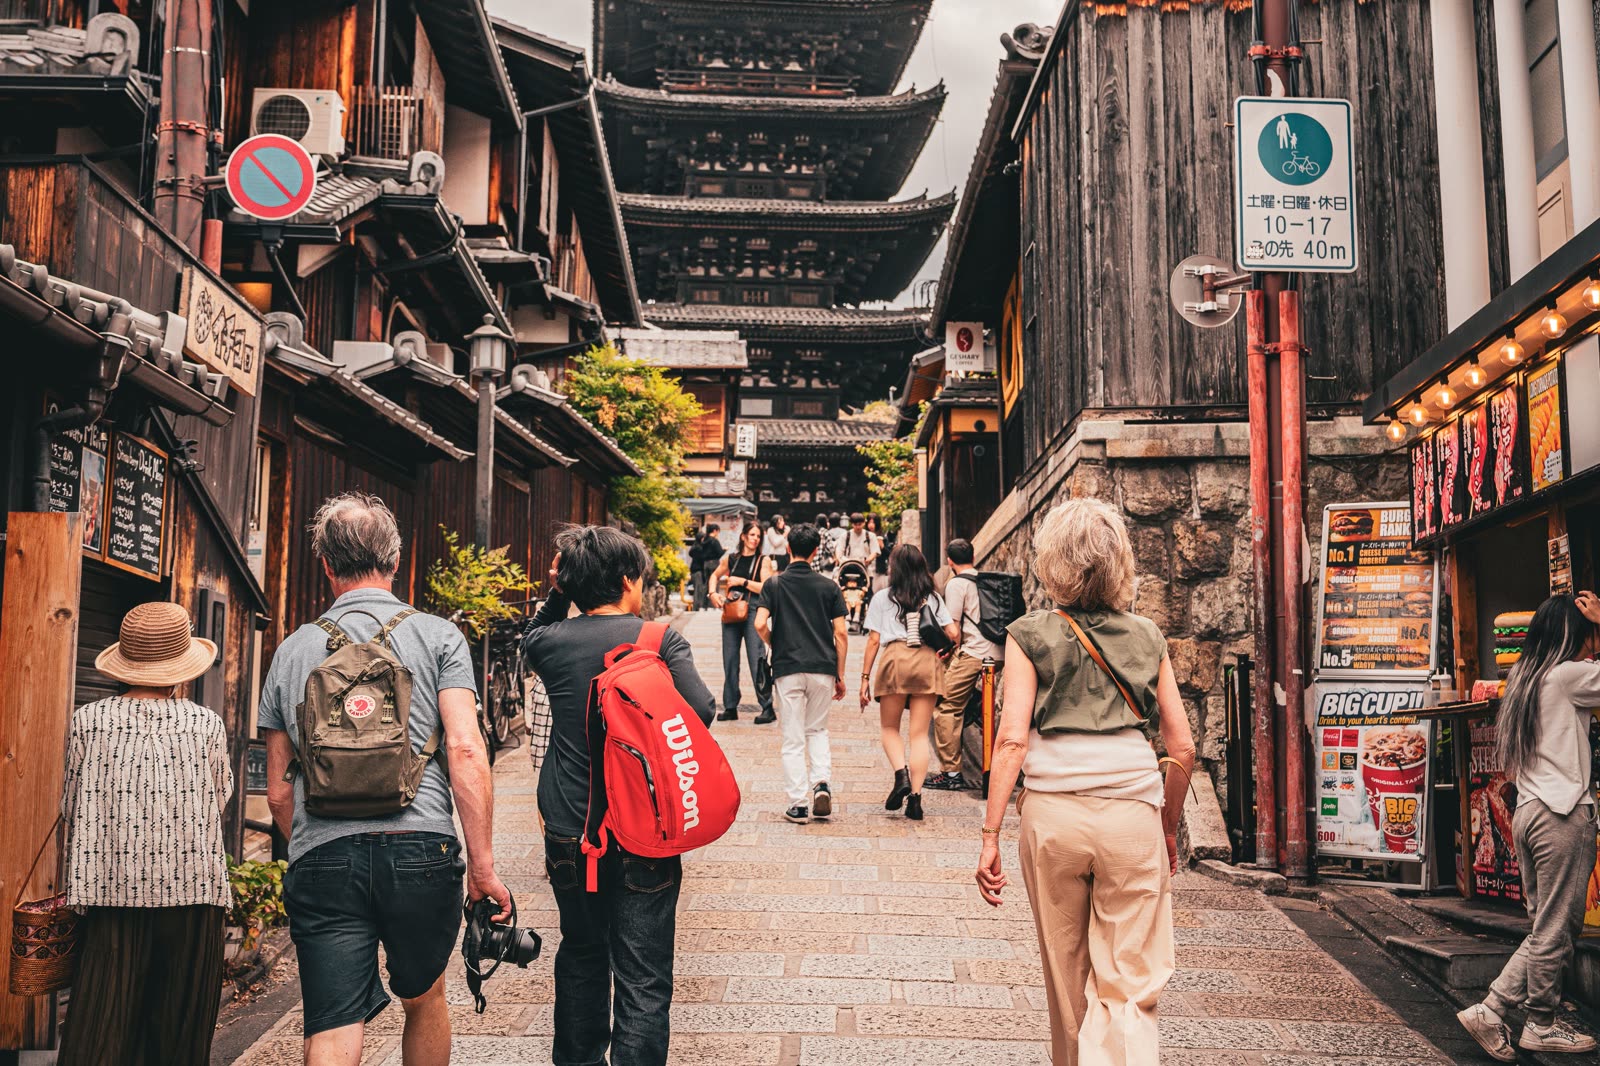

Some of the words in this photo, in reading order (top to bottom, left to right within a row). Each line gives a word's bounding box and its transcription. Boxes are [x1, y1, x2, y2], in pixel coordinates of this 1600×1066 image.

[1246, 194, 1347, 211] 土曜・日曜・休日
[1303, 240, 1346, 259] 40m
[1380, 509, 1410, 523] BURG
[1379, 523, 1411, 537] RANK
[1328, 545, 1355, 562] No.1
[1382, 548, 1406, 556] BURGER
[1404, 569, 1433, 586] No.2
[1326, 598, 1354, 613] No.3
[1401, 623, 1429, 640] No.4
[1322, 649, 1351, 667] No.5
[1353, 661, 1376, 669] WAGYU
[1319, 716, 1337, 725] Drink
[1339, 716, 1345, 725] to
[1347, 717, 1363, 728] your
[1364, 716, 1388, 725] heart's
[661, 713, 699, 831] Wilson
[1371, 777, 1404, 786] ORIGINAL
[1384, 798, 1417, 815] BIG
[1388, 814, 1413, 823] CUP
